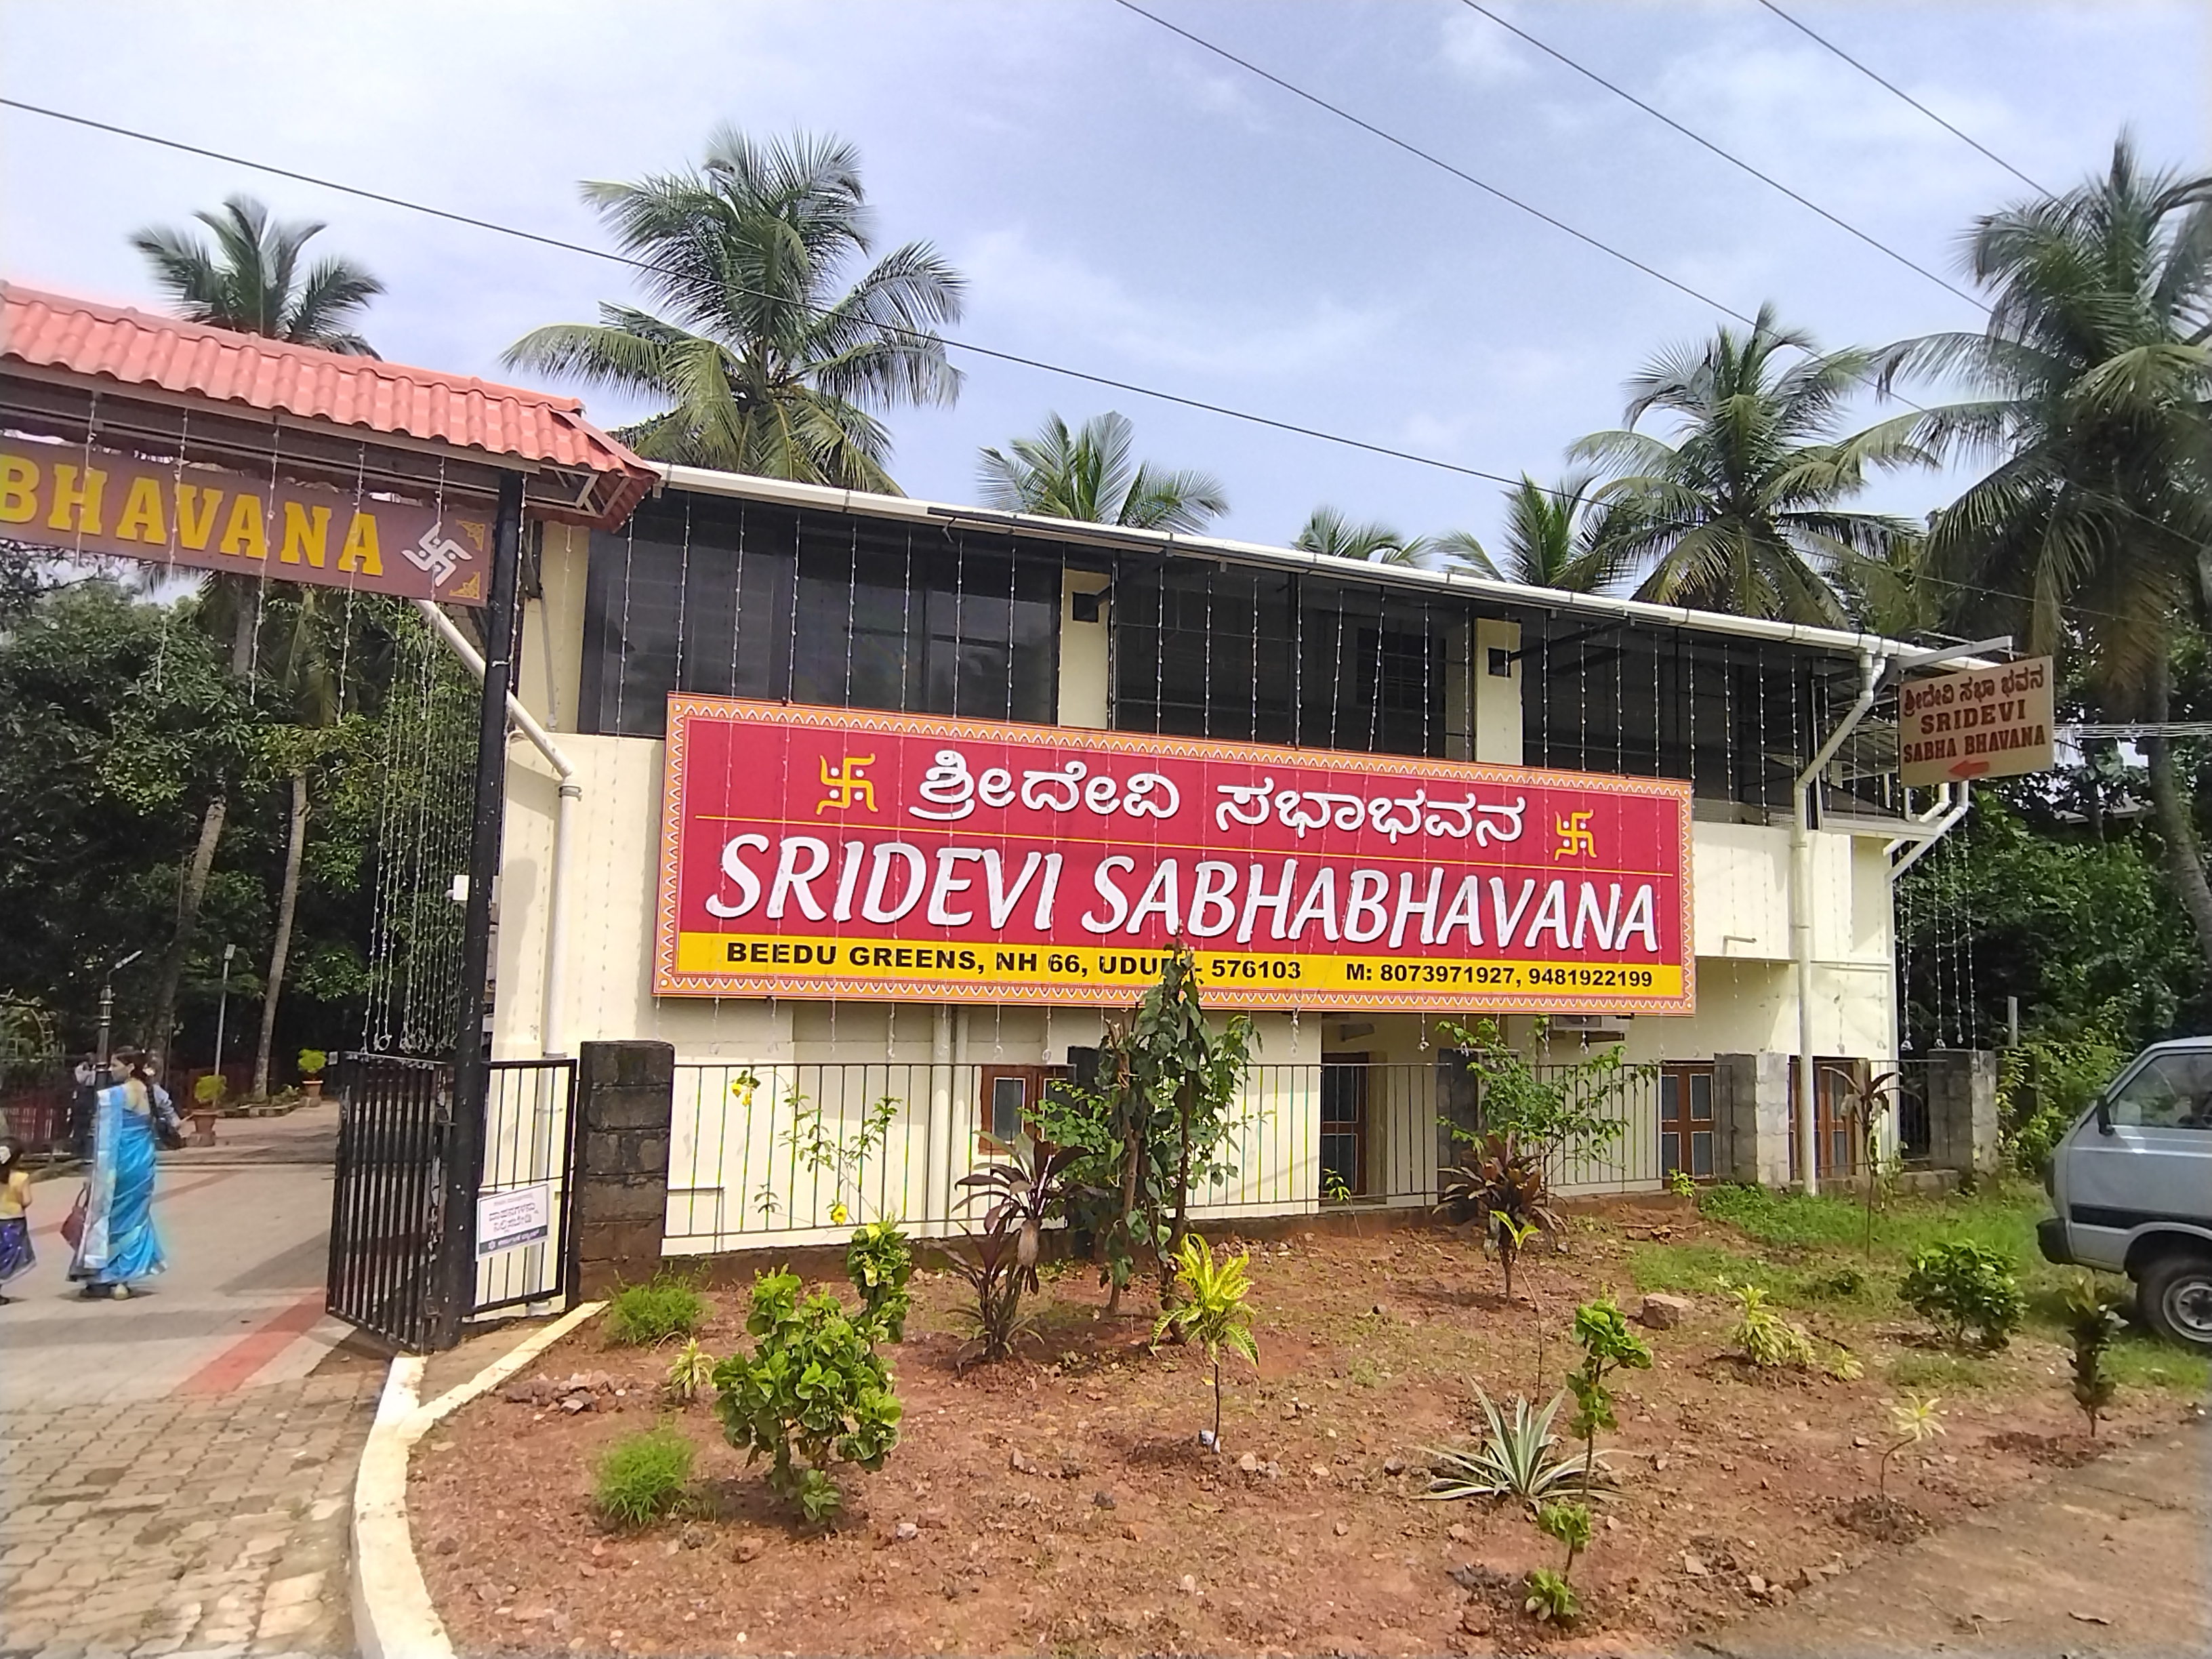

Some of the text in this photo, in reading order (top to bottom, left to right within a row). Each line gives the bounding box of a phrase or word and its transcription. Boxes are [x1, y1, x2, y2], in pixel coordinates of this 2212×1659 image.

[0, 453, 384, 576] BHAVANA
[1903, 724, 2046, 764] SABHA BHAVANA
[1921, 699, 2026, 735] SRIDEVI
[909, 749, 1526, 847] ಶ್ರೀದೇವಿ ಸಭಾಭವನ
[705, 834, 1660, 952] SRIDEVI SABHABHAVANA
[726, 943, 838, 966] BEEDU
[849, 947, 985, 973] GREENS,
[996, 952, 1038, 972] NH
[1049, 954, 1088, 977] 66,
[1099, 956, 1188, 977] UDU
[1211, 959, 1301, 981] 576103
[1346, 964, 1372, 981] M:
[1380, 965, 1521, 987] 8073971927,
[1528, 968, 1653, 988] 9481922199
